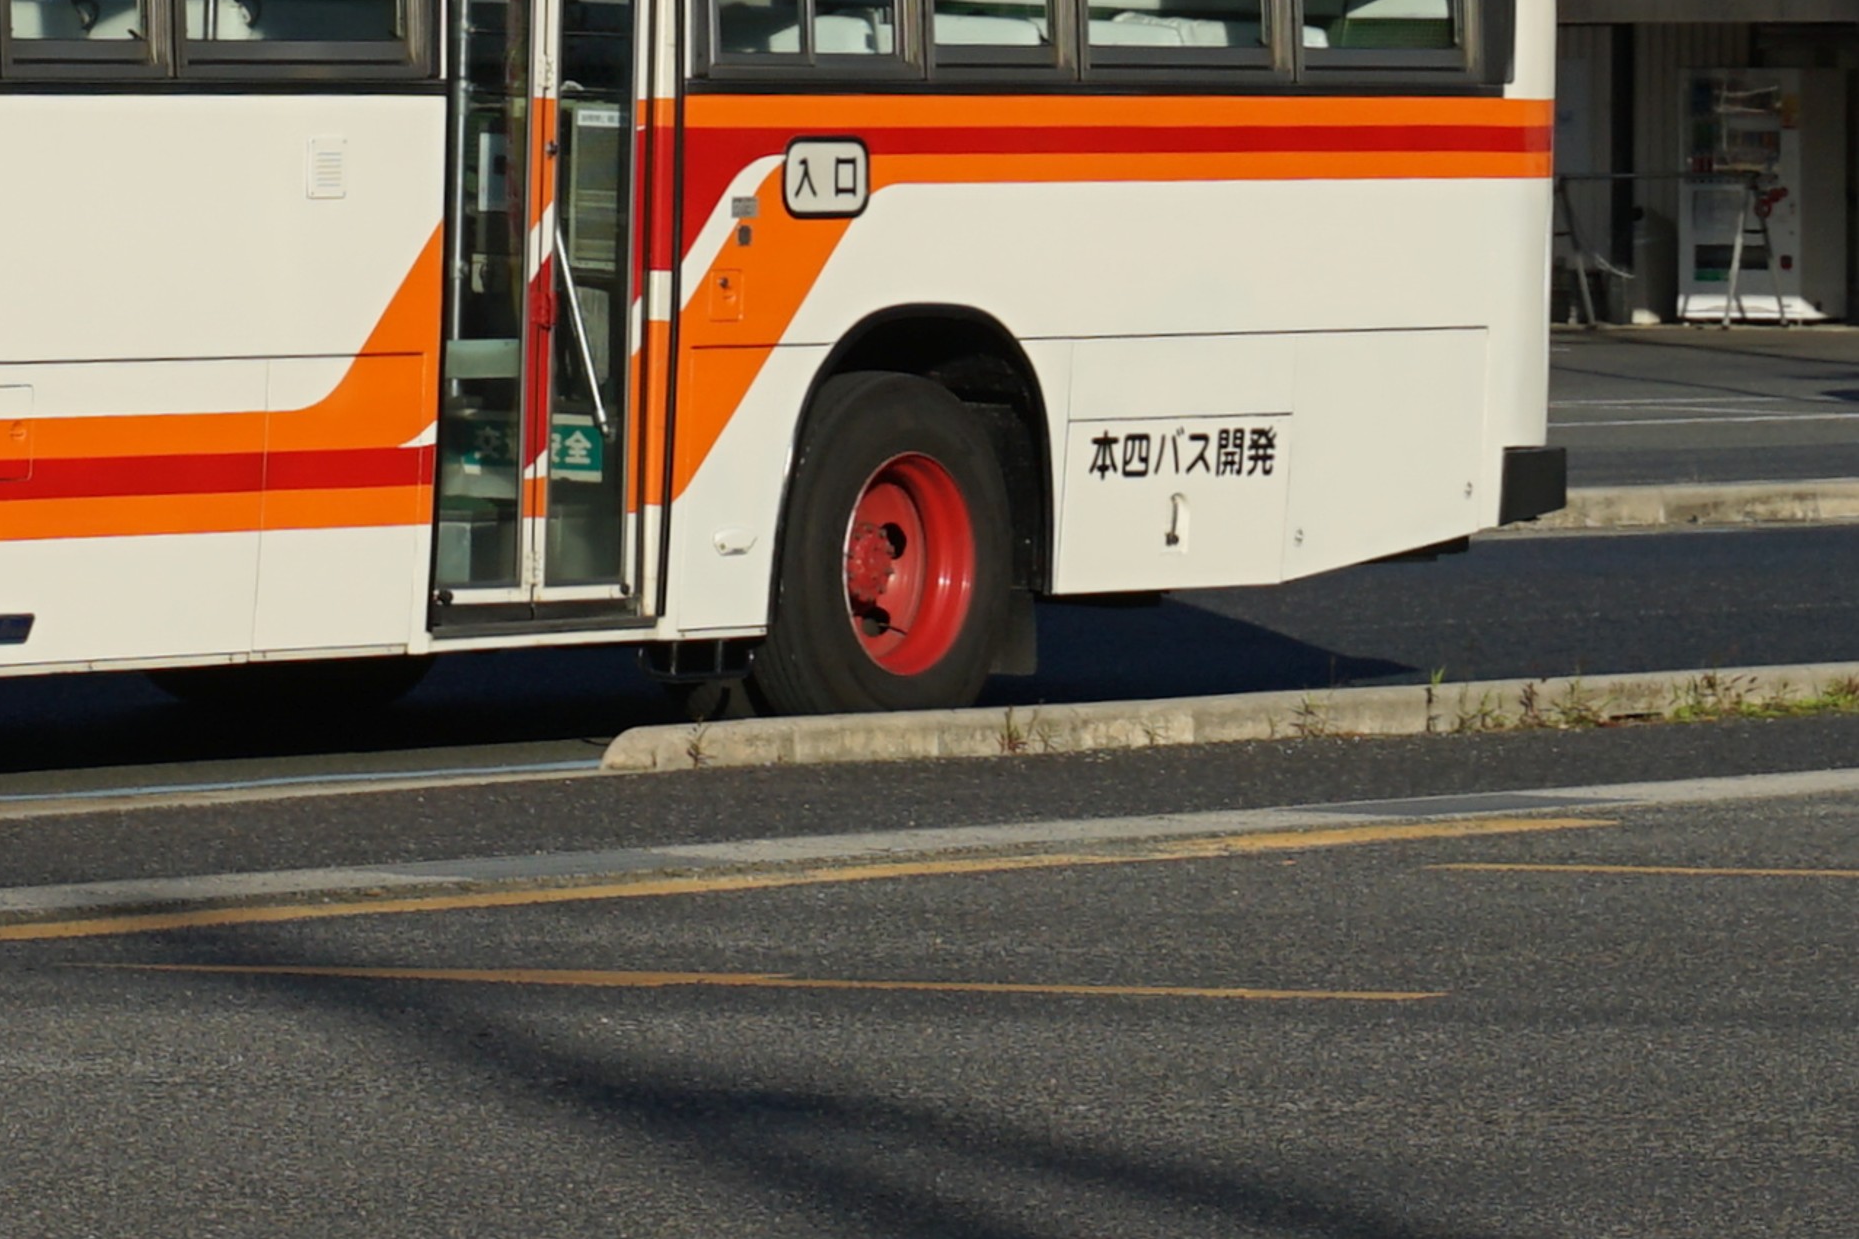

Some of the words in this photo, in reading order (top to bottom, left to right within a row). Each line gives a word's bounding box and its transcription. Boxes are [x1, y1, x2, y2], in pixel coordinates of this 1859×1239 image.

[795, 157, 857, 198] 入口
[1089, 426, 1277, 481] 本四バス開発
